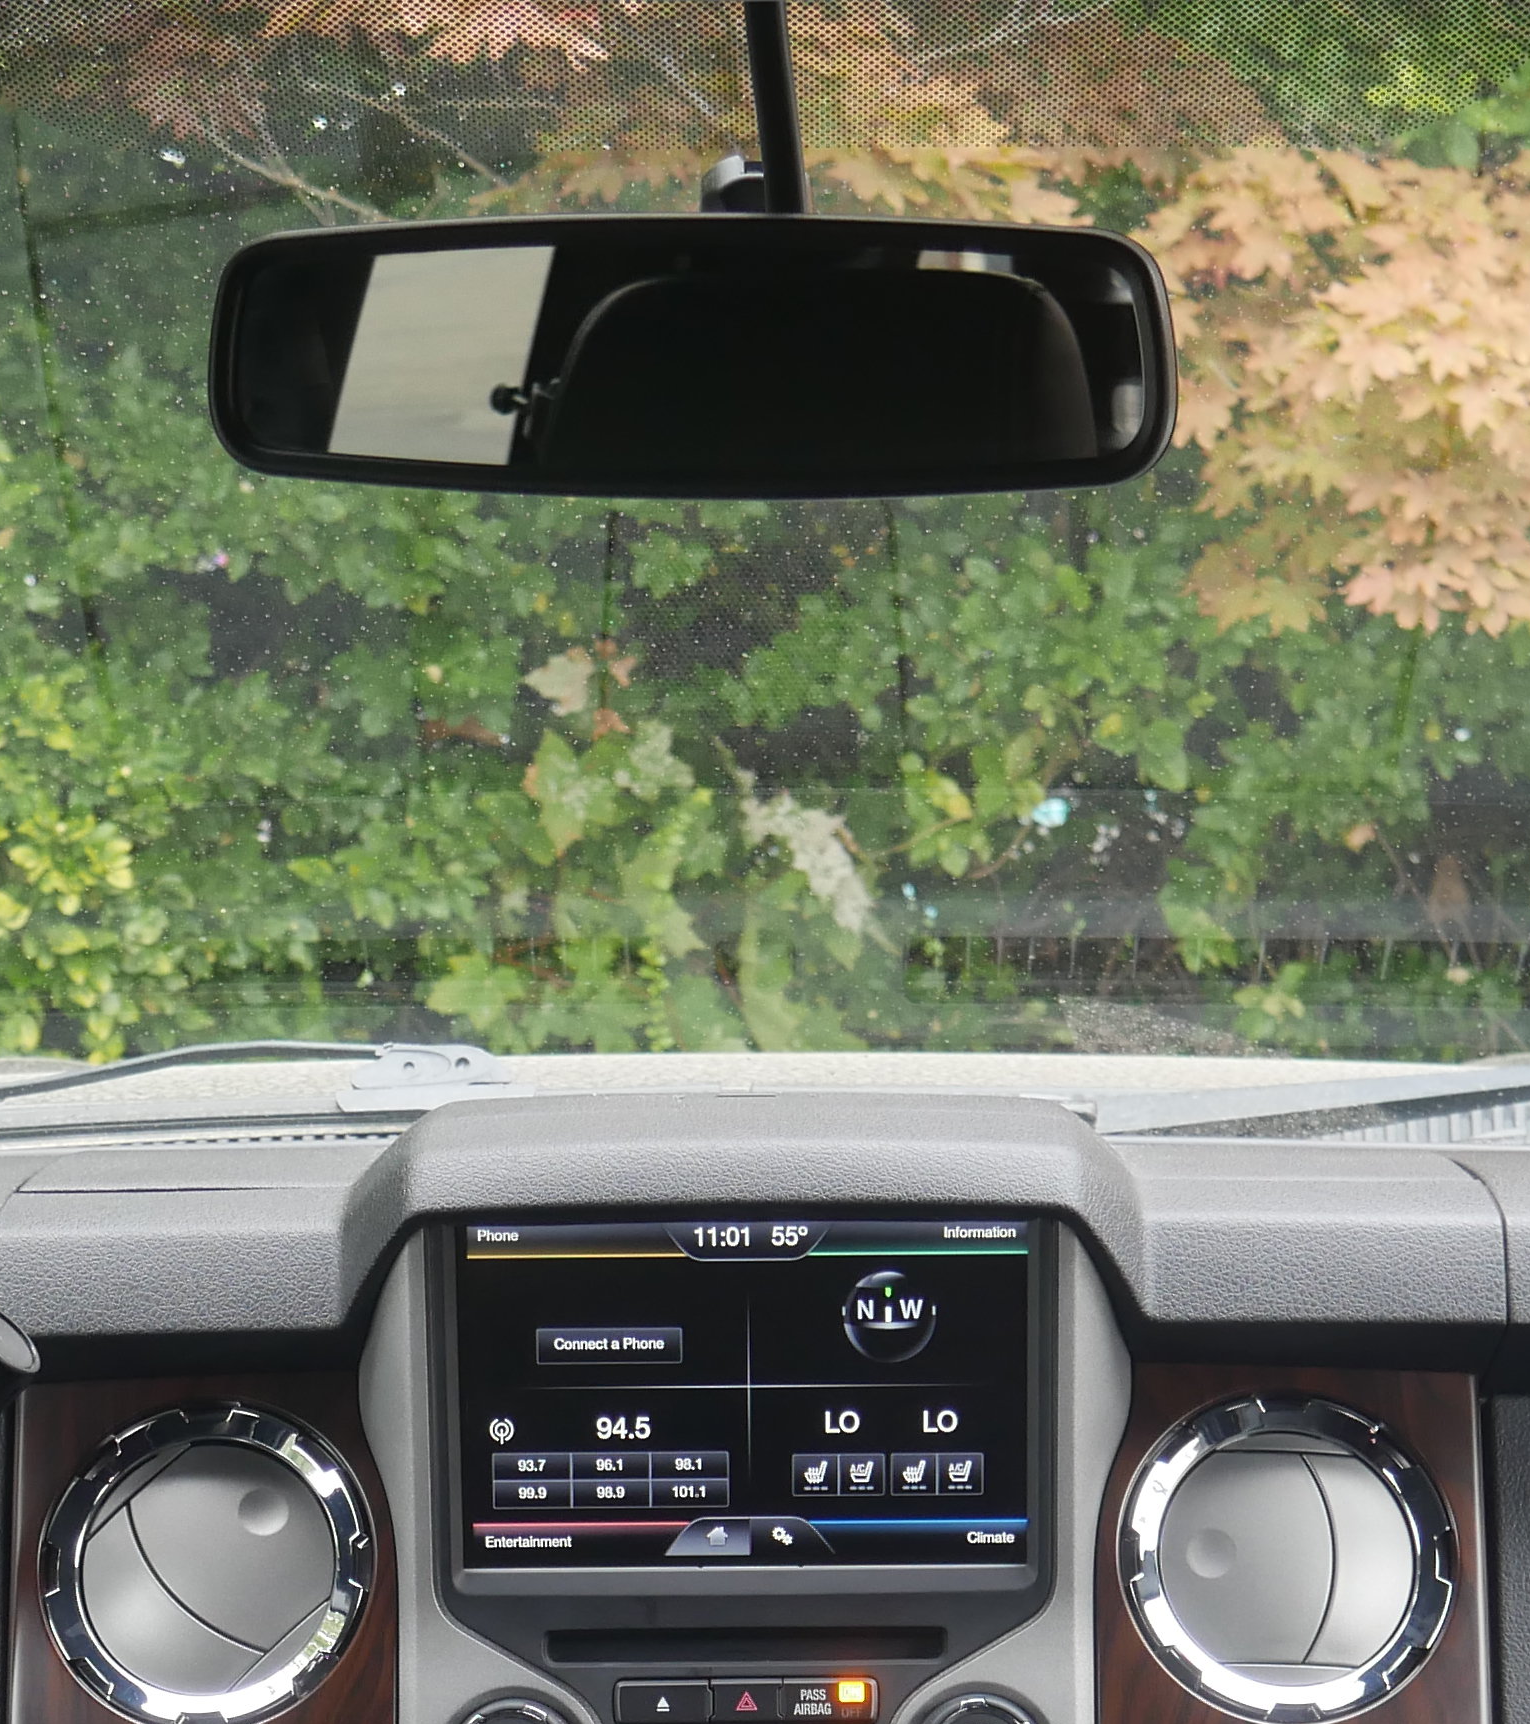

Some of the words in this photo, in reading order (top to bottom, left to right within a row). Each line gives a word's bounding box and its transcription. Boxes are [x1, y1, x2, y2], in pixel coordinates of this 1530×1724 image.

[477, 1229, 519, 1242] Phone
[694, 1226, 750, 1247] 11:01
[943, 1225, 1016, 1239] Information
[857, 1300, 875, 1321] N
[899, 1299, 924, 1320] W
[554, 1337, 608, 1351] Connect
[611, 1340, 620, 1350] a
[623, 1337, 665, 1350] Phone
[596, 1416, 651, 1440] 94.5
[824, 1410, 860, 1434] LO
[923, 1410, 958, 1433] LO
[518, 1459, 546, 1472] 93.7
[596, 1458, 623, 1471] 96.1
[675, 1458, 703, 1471] 98.1
[518, 1486, 547, 1499] 99.9
[596, 1486, 625, 1499] 98.9
[672, 1485, 706, 1498] 101.1
[484, 1535, 572, 1549] Entertainment
[967, 1531, 1015, 1544] Climate
[800, 1689, 826, 1701] PASS
[794, 1703, 832, 1716] AIRBAG
